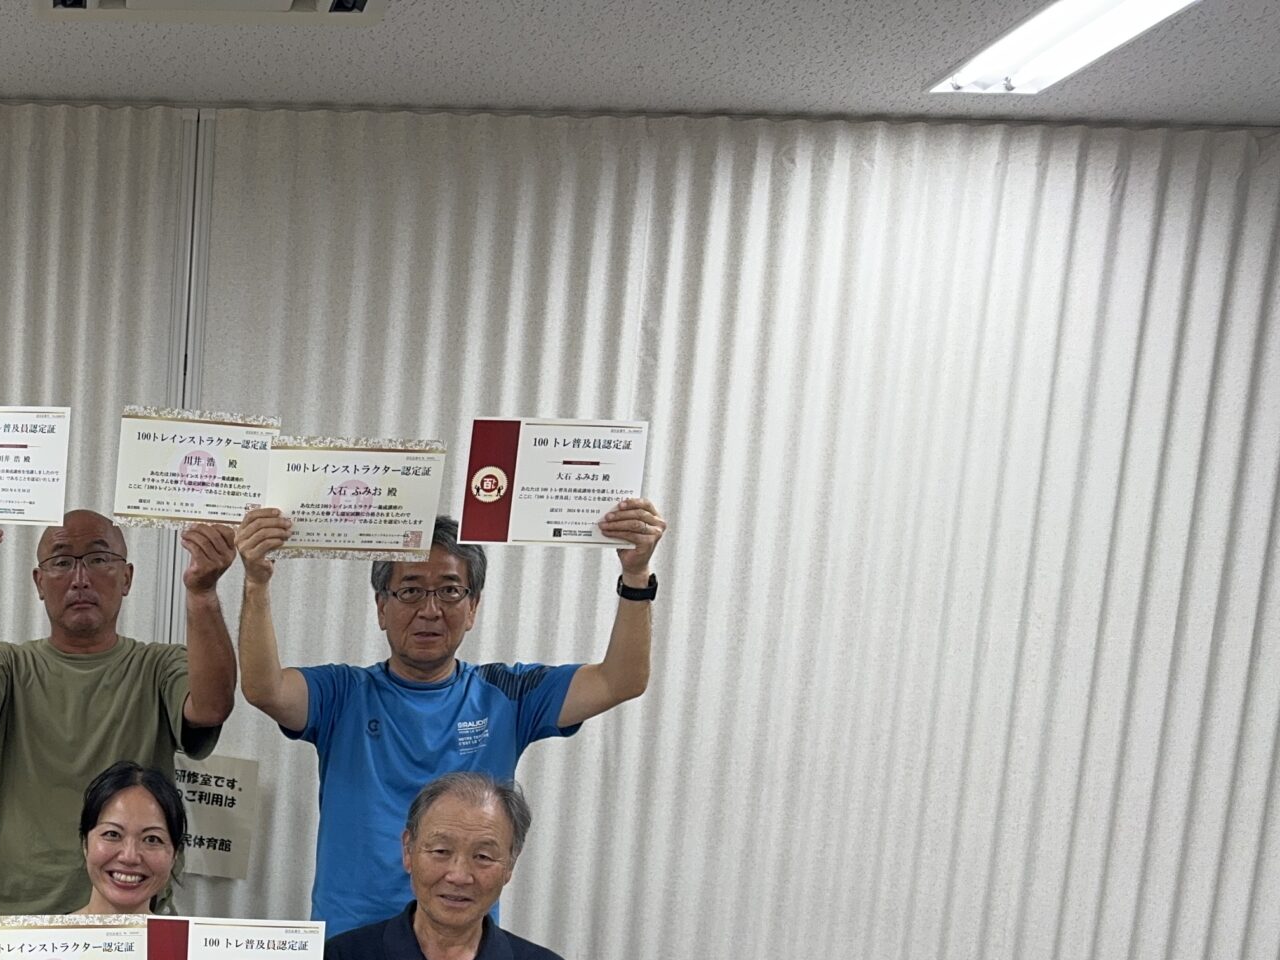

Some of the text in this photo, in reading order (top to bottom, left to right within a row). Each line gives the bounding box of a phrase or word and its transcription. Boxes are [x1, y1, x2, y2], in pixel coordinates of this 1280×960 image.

[137, 431, 269, 450] 100トレインストラクター認定証
[183, 455, 203, 466] 川井
[228, 459, 238, 469] 殿
[286, 463, 432, 477] 100トレインストラクター認定証
[556, 472, 571, 480] 大石
[575, 473, 599, 481] ふみお
[328, 485, 398, 497] 大石 ふみお 殿
